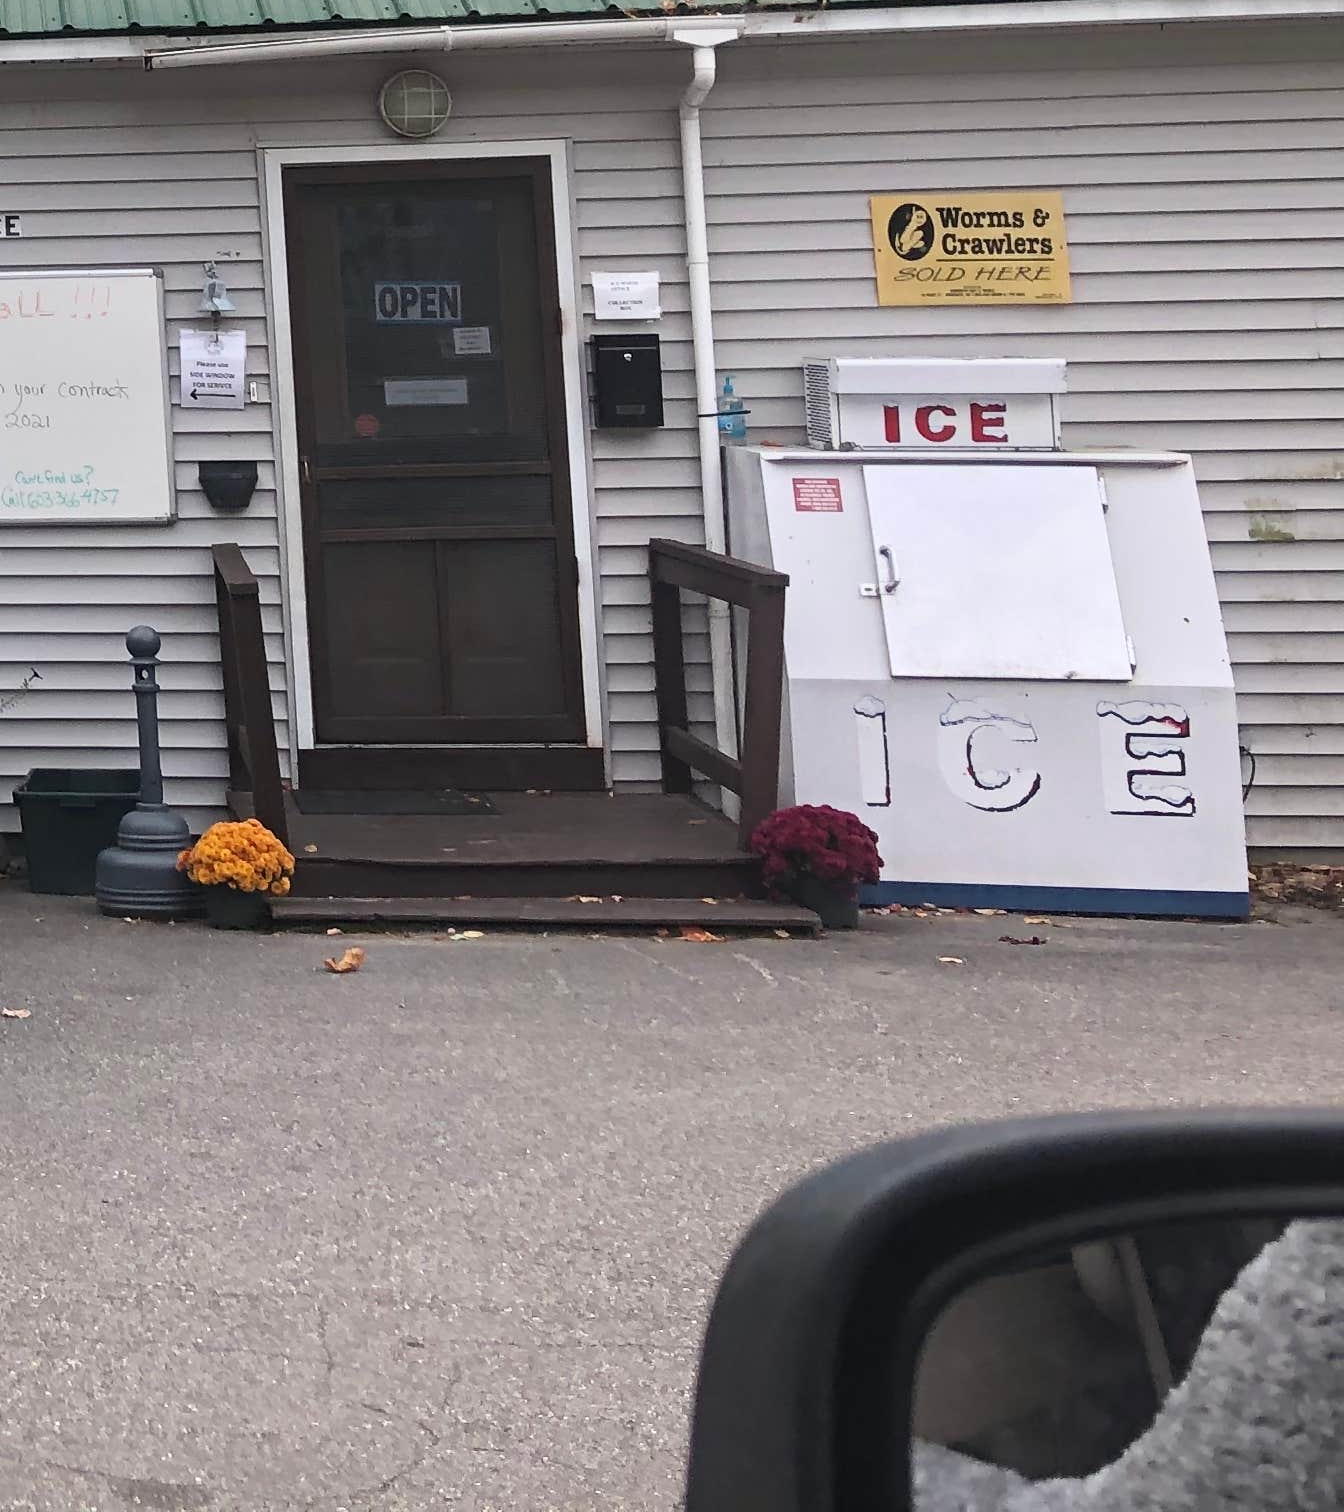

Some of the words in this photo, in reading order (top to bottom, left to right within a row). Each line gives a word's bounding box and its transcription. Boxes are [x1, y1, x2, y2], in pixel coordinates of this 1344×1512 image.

[936, 206, 1025, 229] Worms
[1032, 208, 1050, 228] &
[941, 232, 1053, 256] Crawlers
[893, 266, 966, 283] SOLD
[974, 265, 1052, 282] HERE
[377, 286, 460, 319] OPEN
[14, 383, 47, 414] your
[4, 411, 51, 429] 2021
[883, 401, 1009, 444] ICE
[853, 692, 1197, 818] ICE
